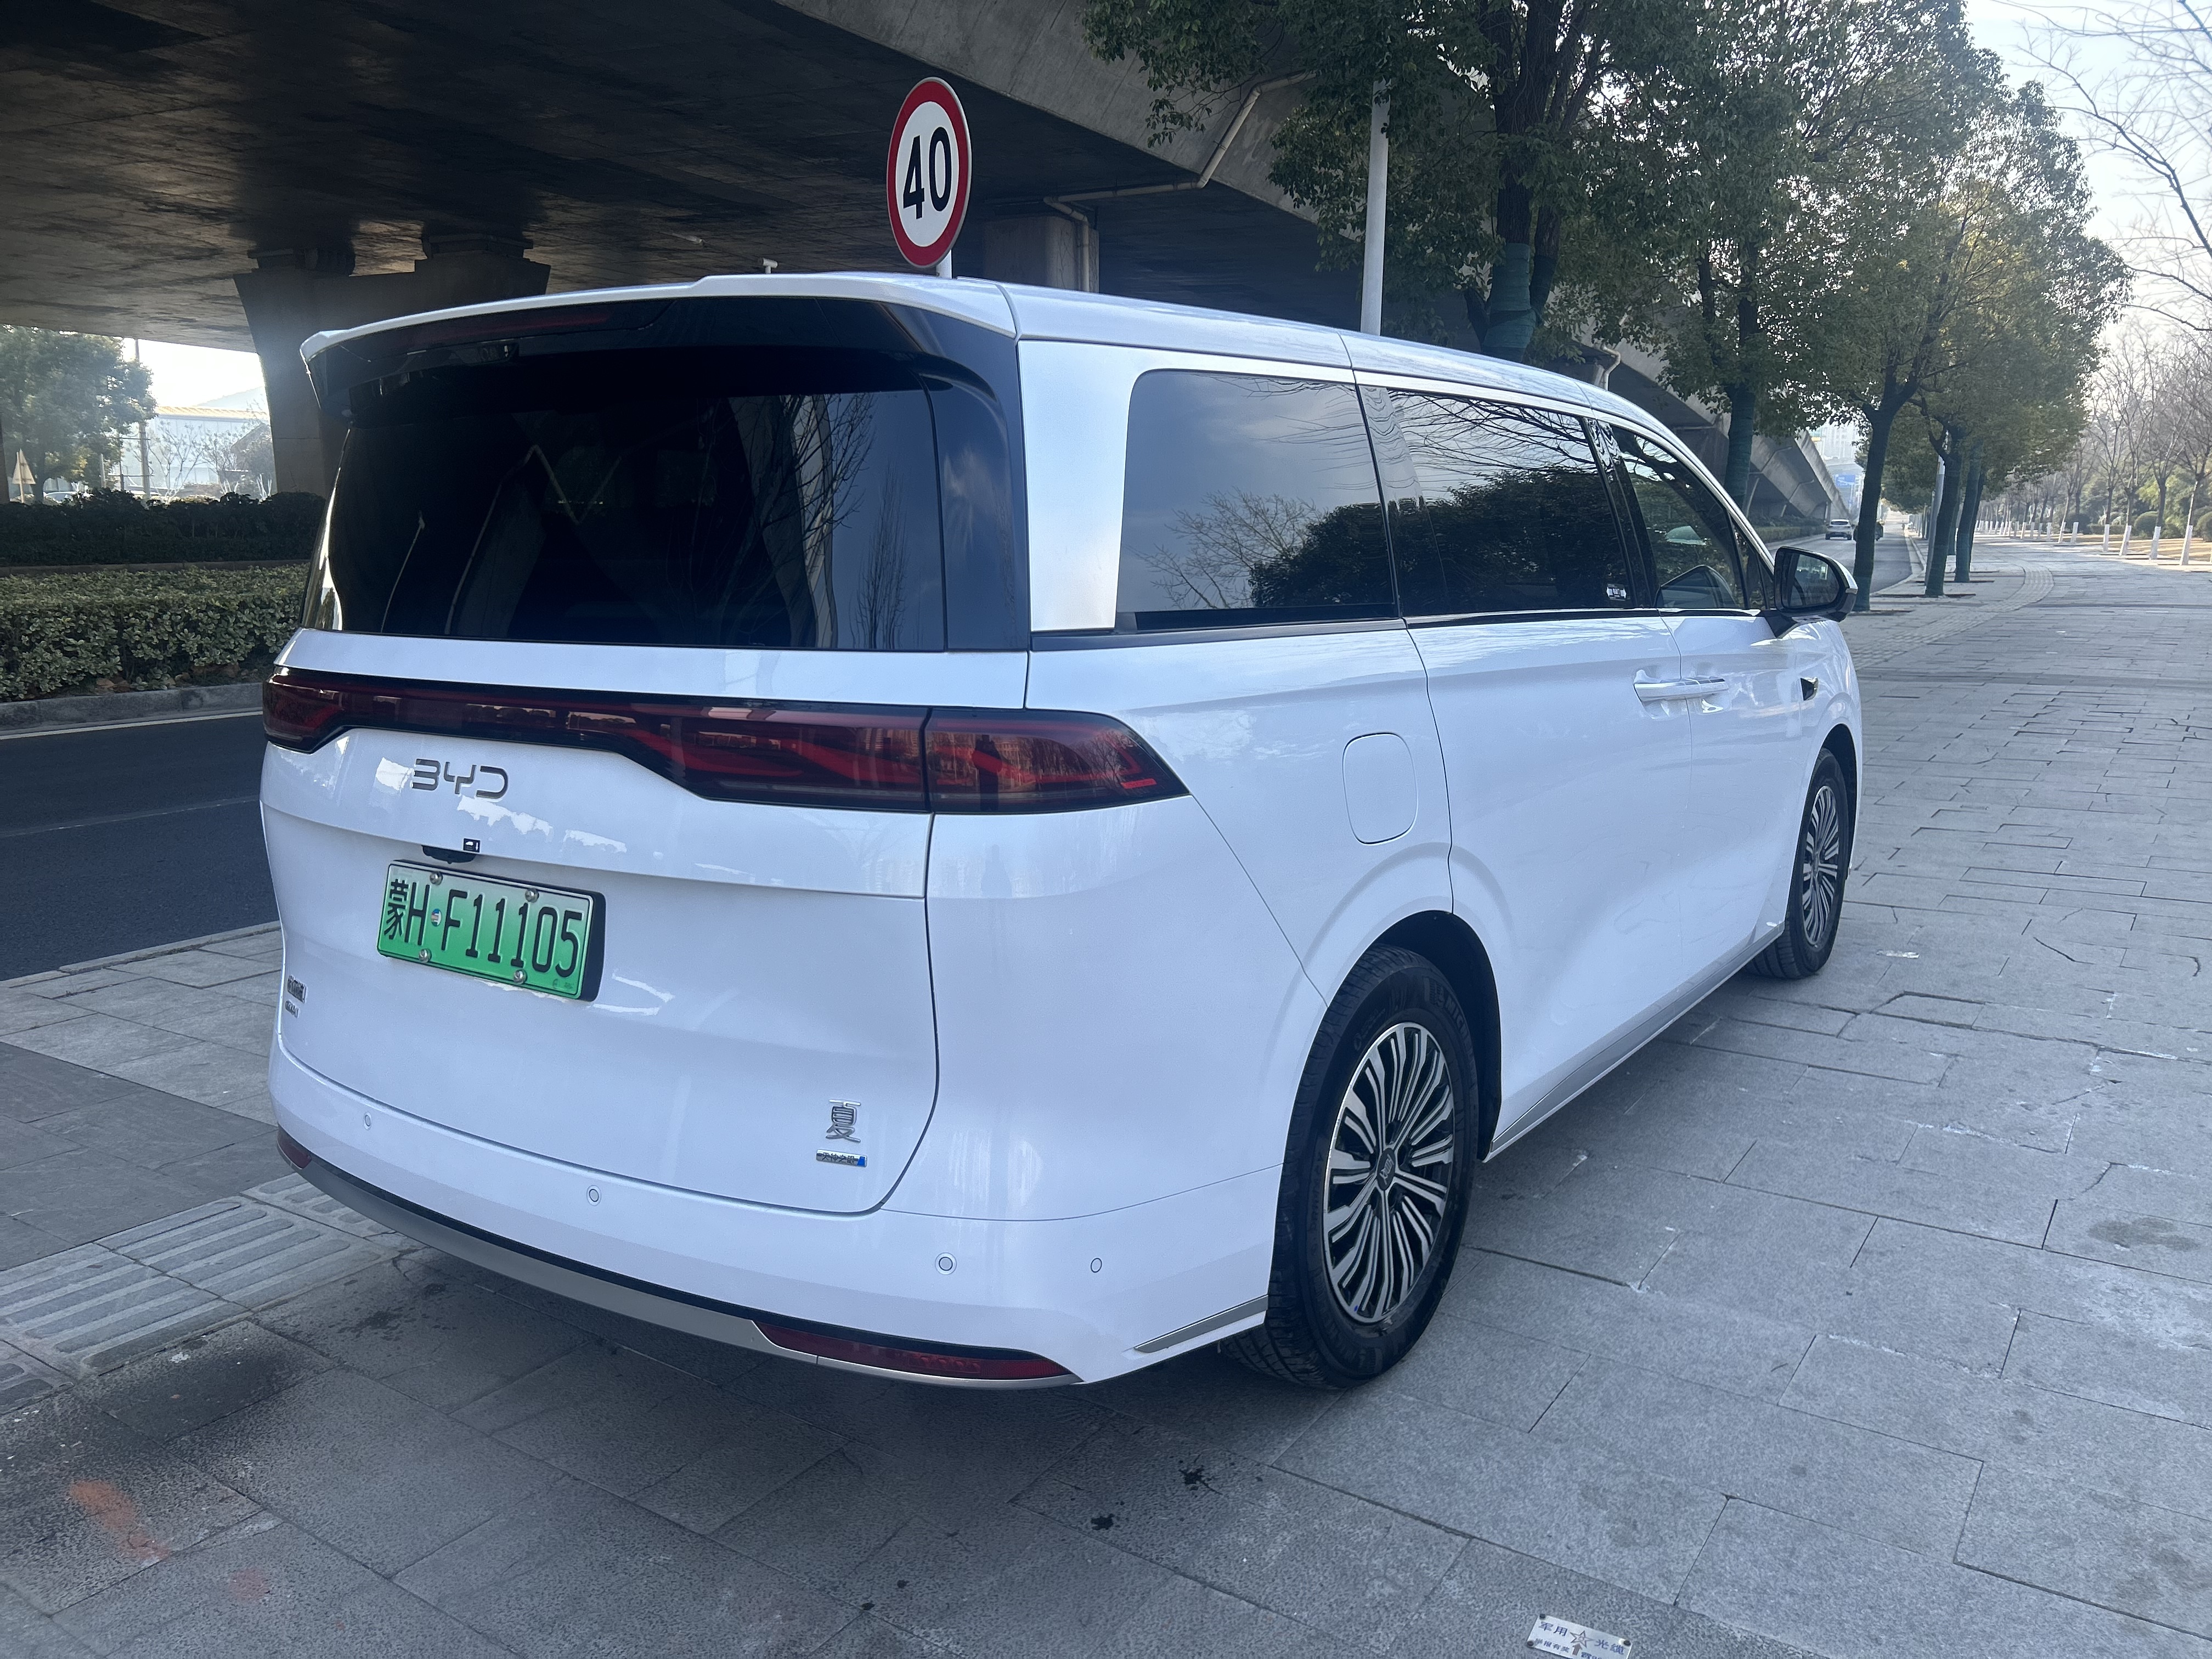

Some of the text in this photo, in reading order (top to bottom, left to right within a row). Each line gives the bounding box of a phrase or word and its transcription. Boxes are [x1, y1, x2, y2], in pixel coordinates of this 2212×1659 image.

[903, 127, 952, 219] 40
[411, 758, 509, 799] BYD
[826, 1099, 861, 1143] 夏
[1538, 1621, 1568, 1637] 军用
